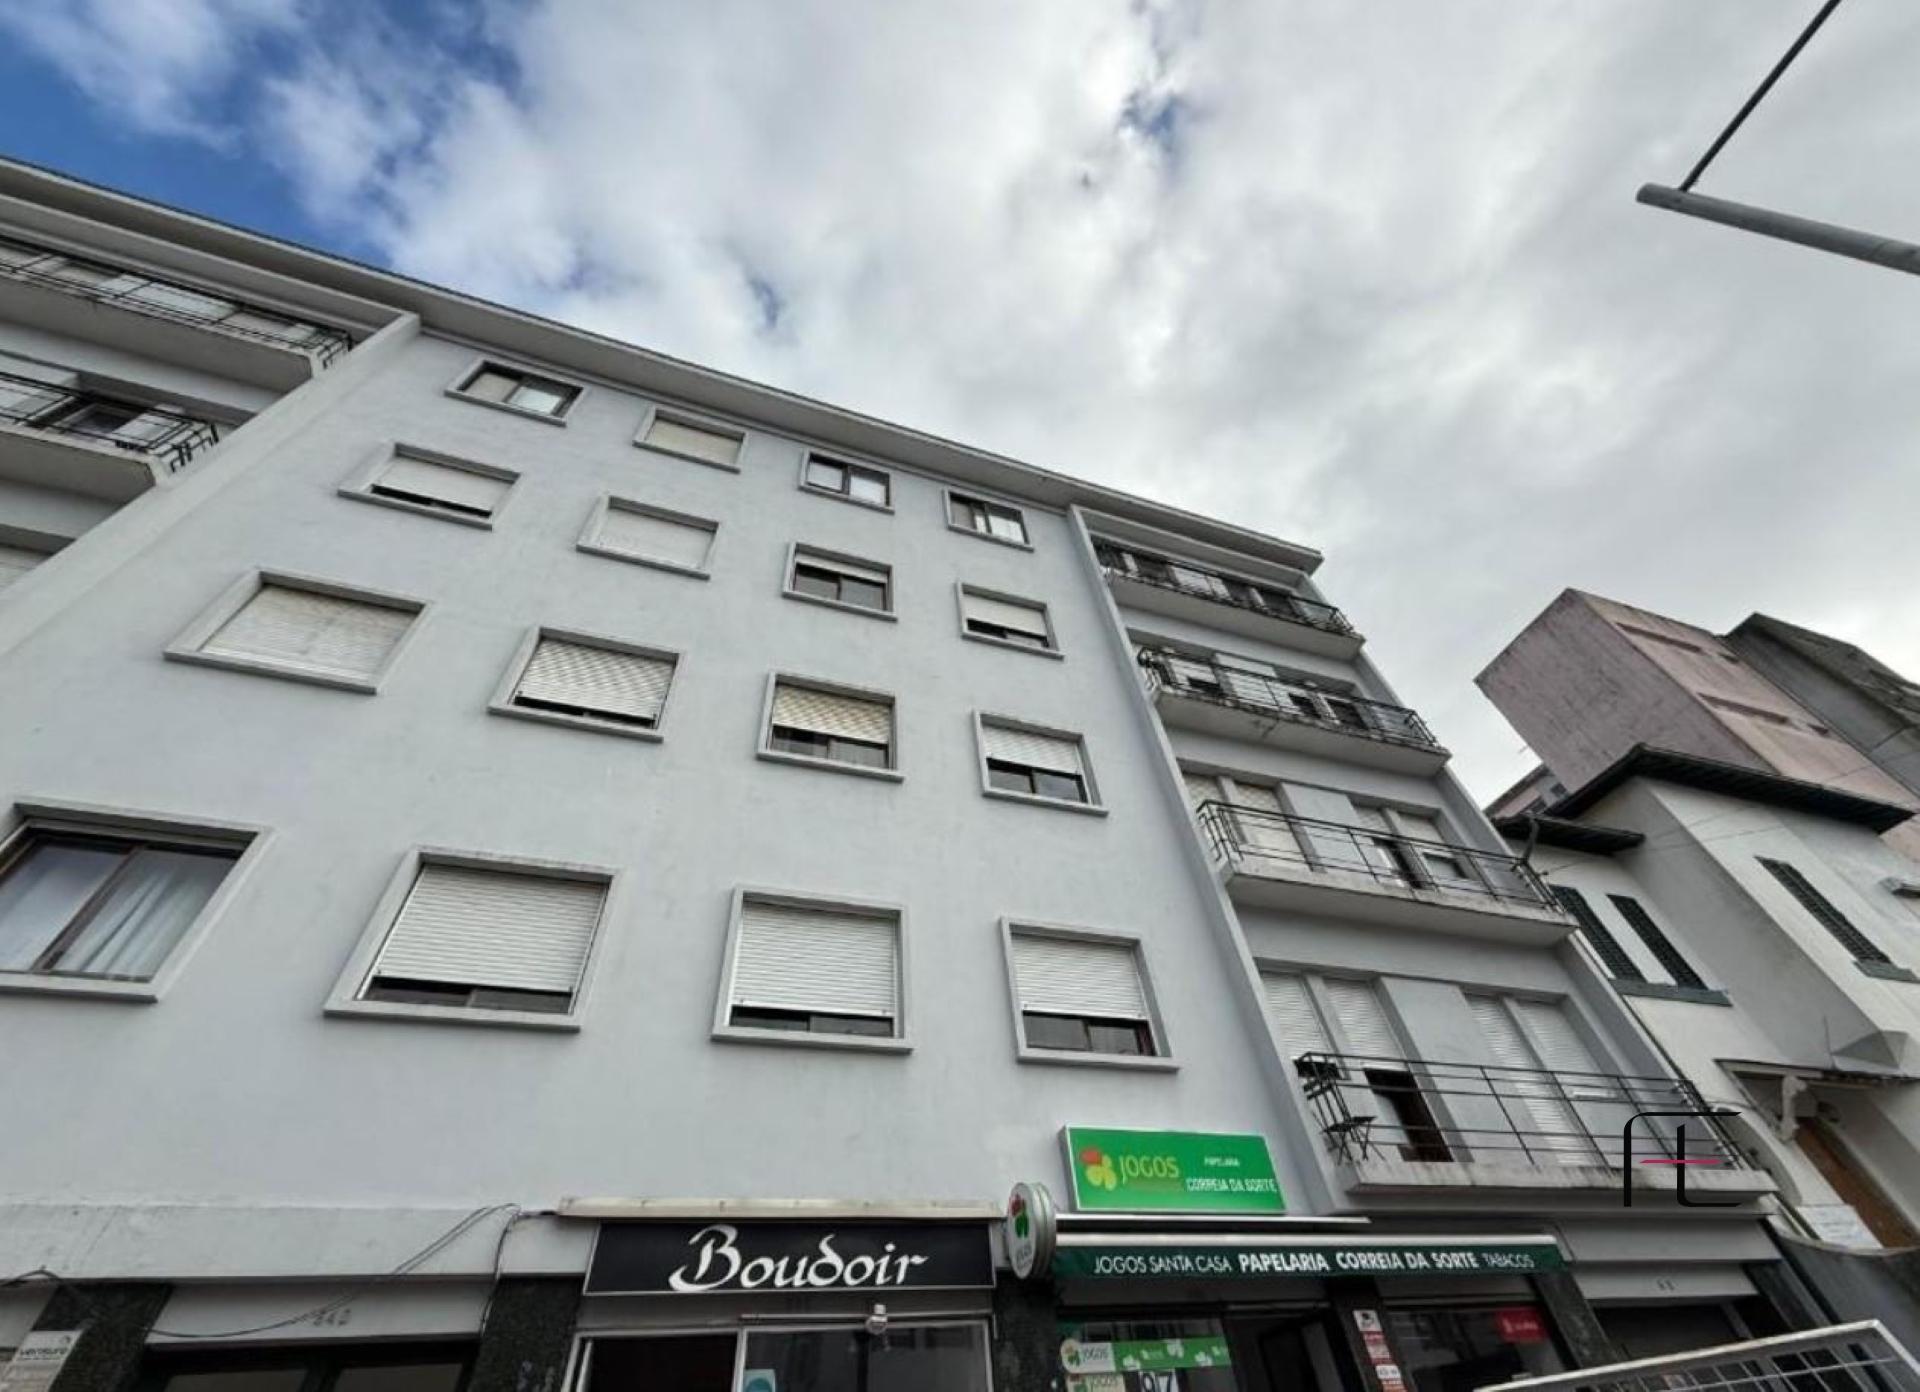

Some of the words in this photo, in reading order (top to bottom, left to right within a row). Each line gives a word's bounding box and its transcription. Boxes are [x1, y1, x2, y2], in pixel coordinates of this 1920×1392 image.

[1119, 1155, 1179, 1184] JOGOS
[1186, 1178, 1229, 1192] CORREIA
[1230, 1179, 1244, 1192] DA
[1245, 1178, 1277, 1192] SORTE
[668, 1224, 929, 1292] Boudoir
[1094, 1256, 1147, 1273] JOGOS
[1150, 1256, 1194, 1272] SANTA
[1196, 1256, 1232, 1272] CASA
[1238, 1253, 1329, 1272] PAPELARIA
[1336, 1252, 1405, 1269] CORREIA
[1404, 1253, 1431, 1269] DA
[1433, 1252, 1480, 1268] SORTE
[1482, 1253, 1535, 1268] TABACOS
